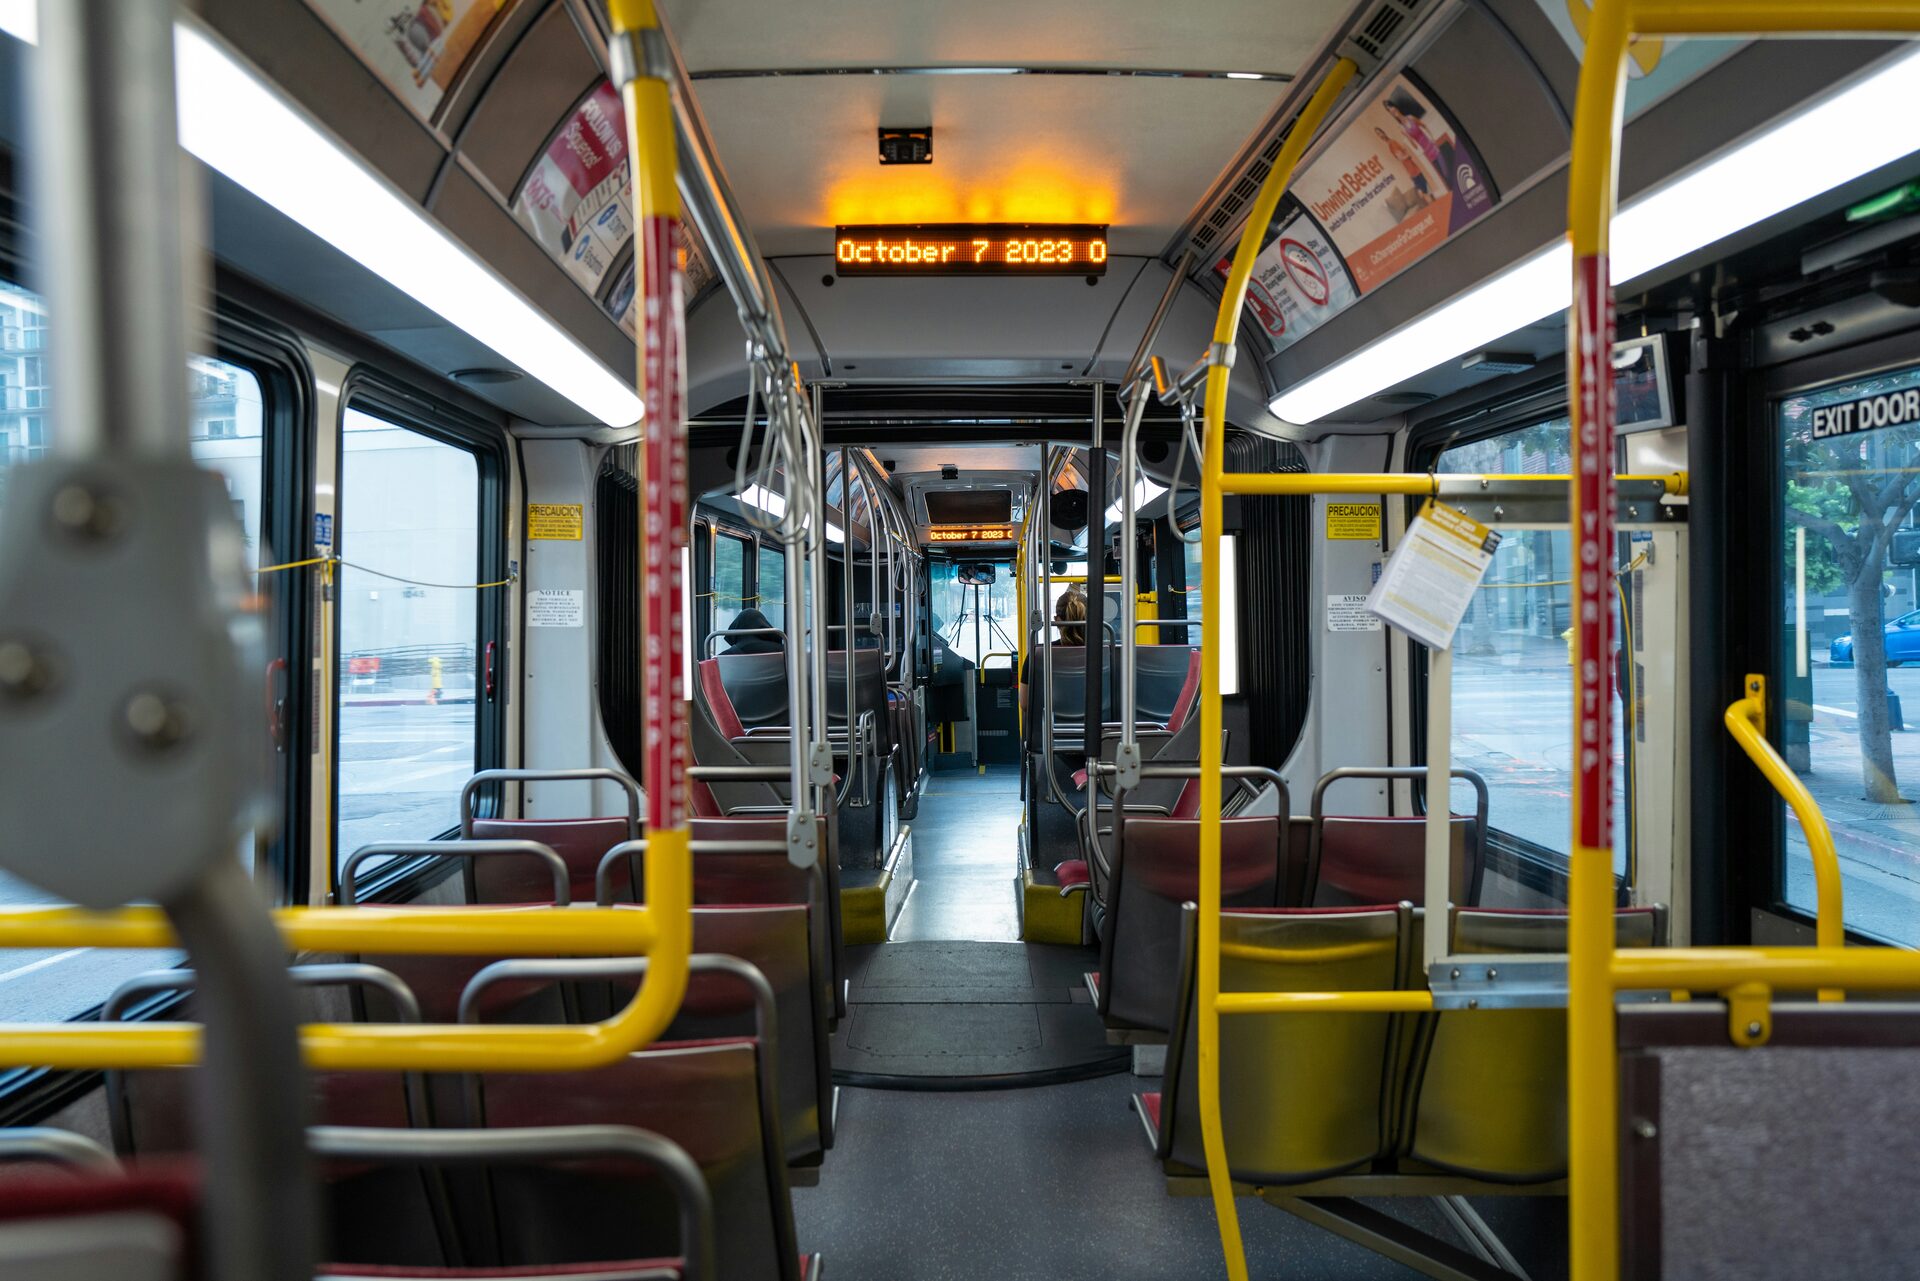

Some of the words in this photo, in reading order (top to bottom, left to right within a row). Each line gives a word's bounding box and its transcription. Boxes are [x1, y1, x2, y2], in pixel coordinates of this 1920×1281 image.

[579, 97, 616, 144] FOLLOW
[1311, 178, 1354, 221] Unwind
[1342, 154, 1385, 193] Better
[838, 240, 955, 263] October
[972, 240, 989, 263] 7
[1006, 240, 1073, 263] 2023
[1813, 403, 1854, 438] EXIT
[1858, 390, 1919, 430] DOOR
[530, 506, 581, 516] PRECAUCION
[1328, 506, 1379, 516] PRECAUCION
[1581, 510, 1598, 623] YOUR
[1581, 658, 1598, 773] STEP
